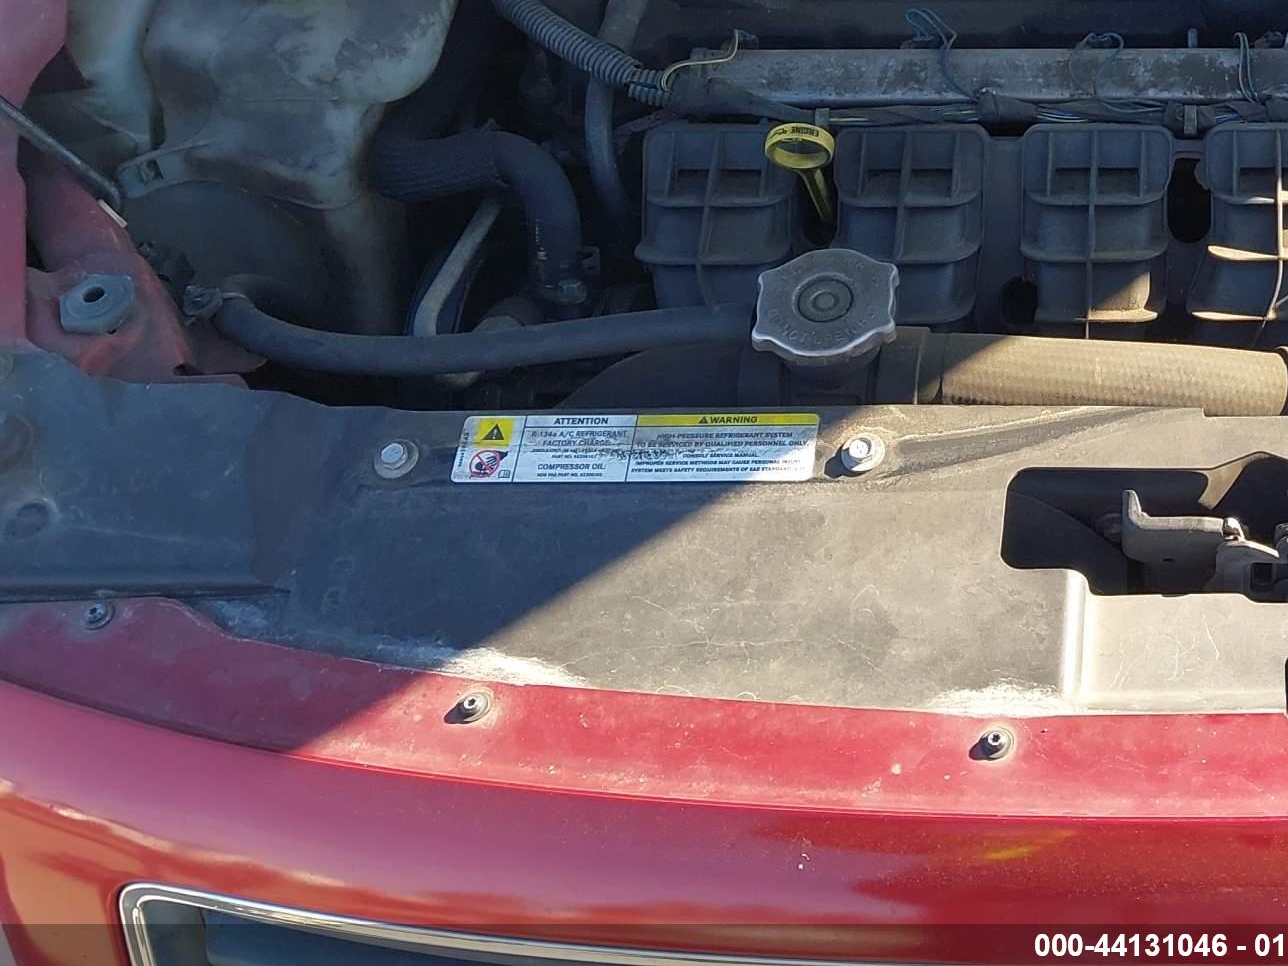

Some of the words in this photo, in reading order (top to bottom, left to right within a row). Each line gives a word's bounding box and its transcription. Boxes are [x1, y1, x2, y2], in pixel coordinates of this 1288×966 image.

[790, 126, 819, 137] ENGINE
[553, 417, 609, 425] ATTENTION
[709, 415, 758, 424] WARNING
[558, 430, 575, 438] A/C
[575, 430, 628, 438] REFRIGERANT
[543, 439, 577, 447] FACTORY
